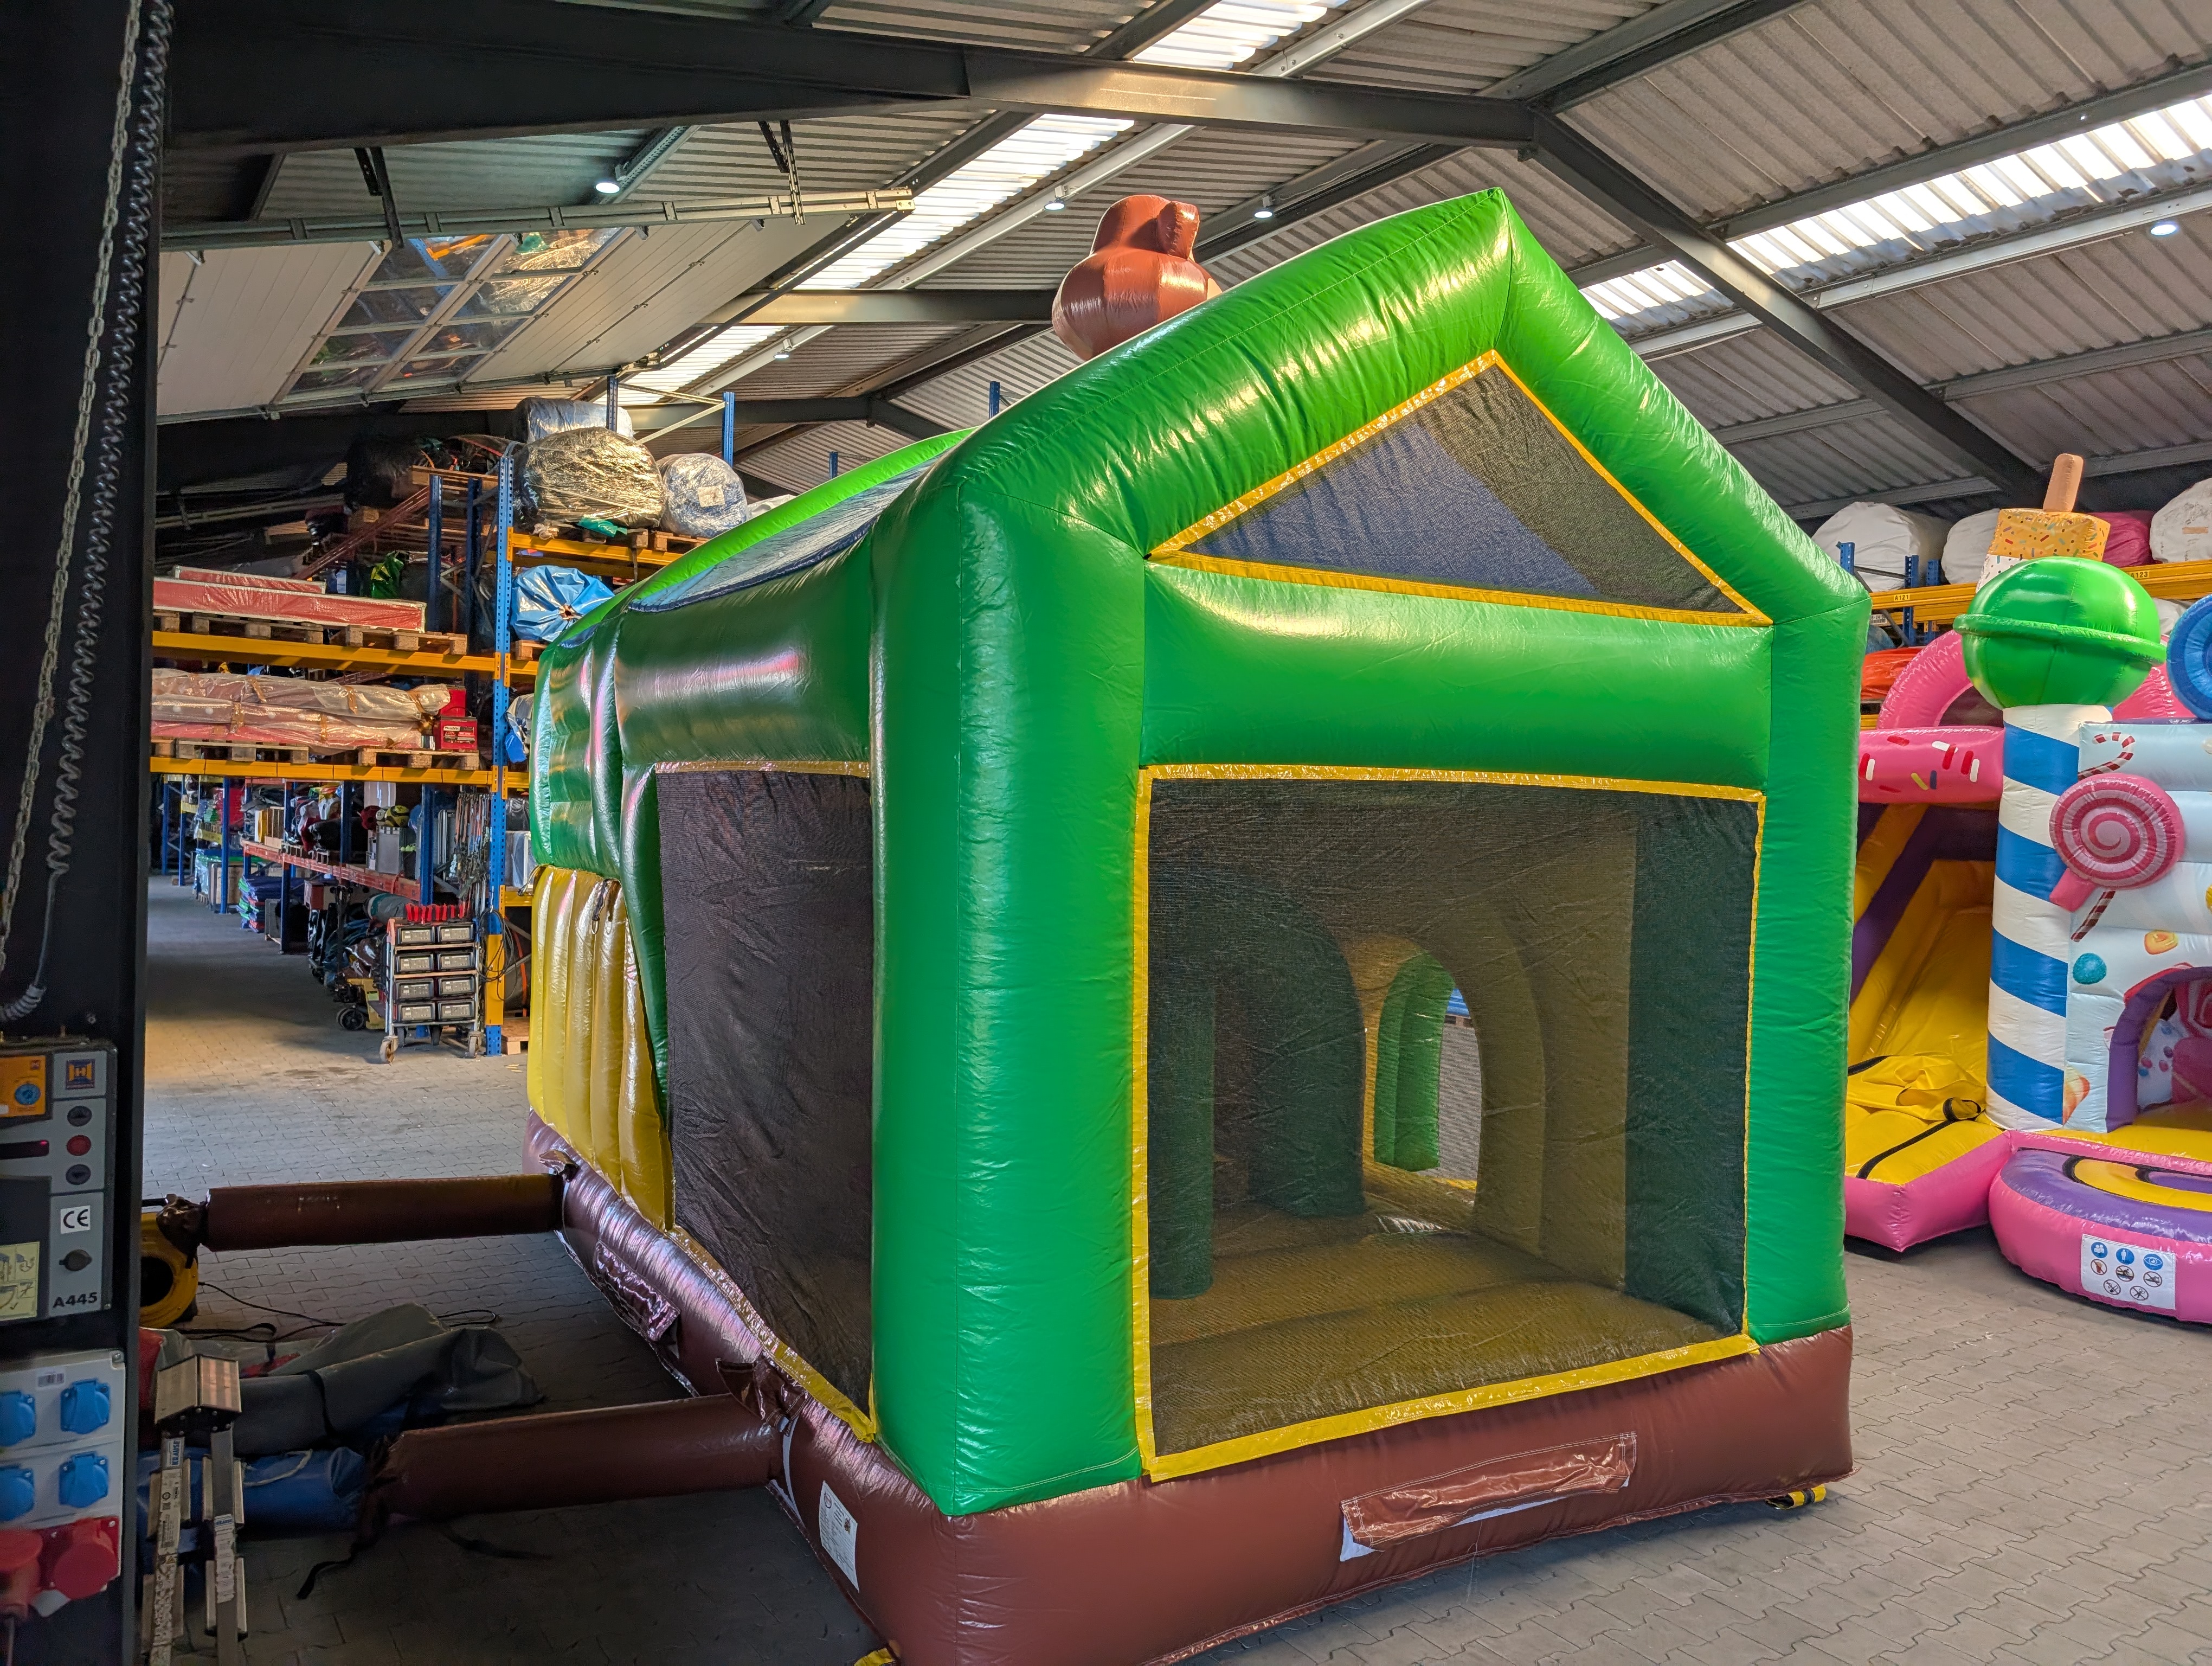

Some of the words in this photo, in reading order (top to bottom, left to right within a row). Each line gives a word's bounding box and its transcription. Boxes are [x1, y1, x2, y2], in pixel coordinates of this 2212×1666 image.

[63, 1209, 89, 1229] CE
[53, 1292, 98, 1308] A445
[172, 1440, 180, 1465] KRAUSE
